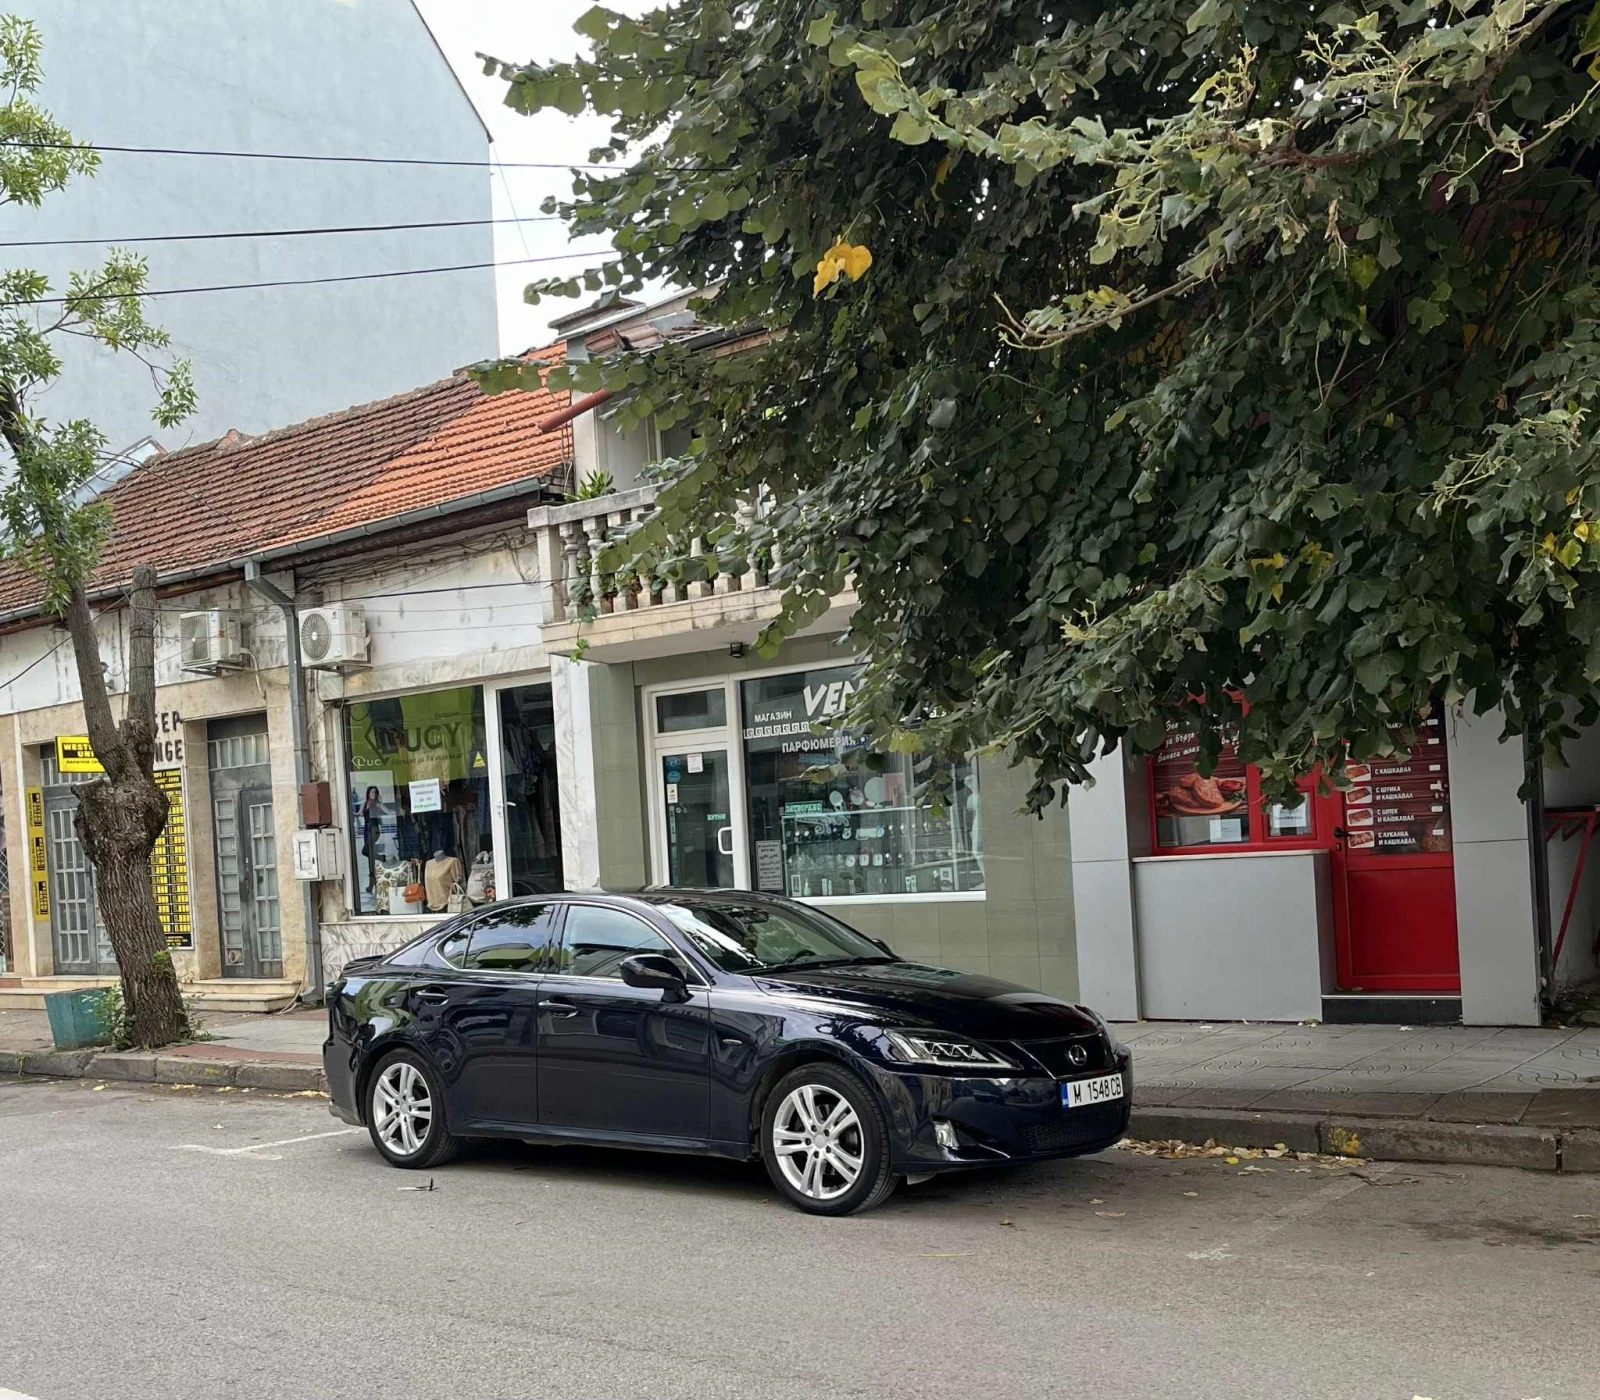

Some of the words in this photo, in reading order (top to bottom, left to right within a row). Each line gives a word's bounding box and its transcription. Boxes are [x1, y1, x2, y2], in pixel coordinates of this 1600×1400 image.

[754, 710, 793, 723] МАГАЗИН
[63, 743, 92, 751] WEST
[782, 736, 857, 753] ПАРФЮМЕРИЯ
[77, 750, 95, 758] UNI
[1379, 766, 1412, 775] КАШКАВАЛ
[1073, 1084, 1082, 1104] M
